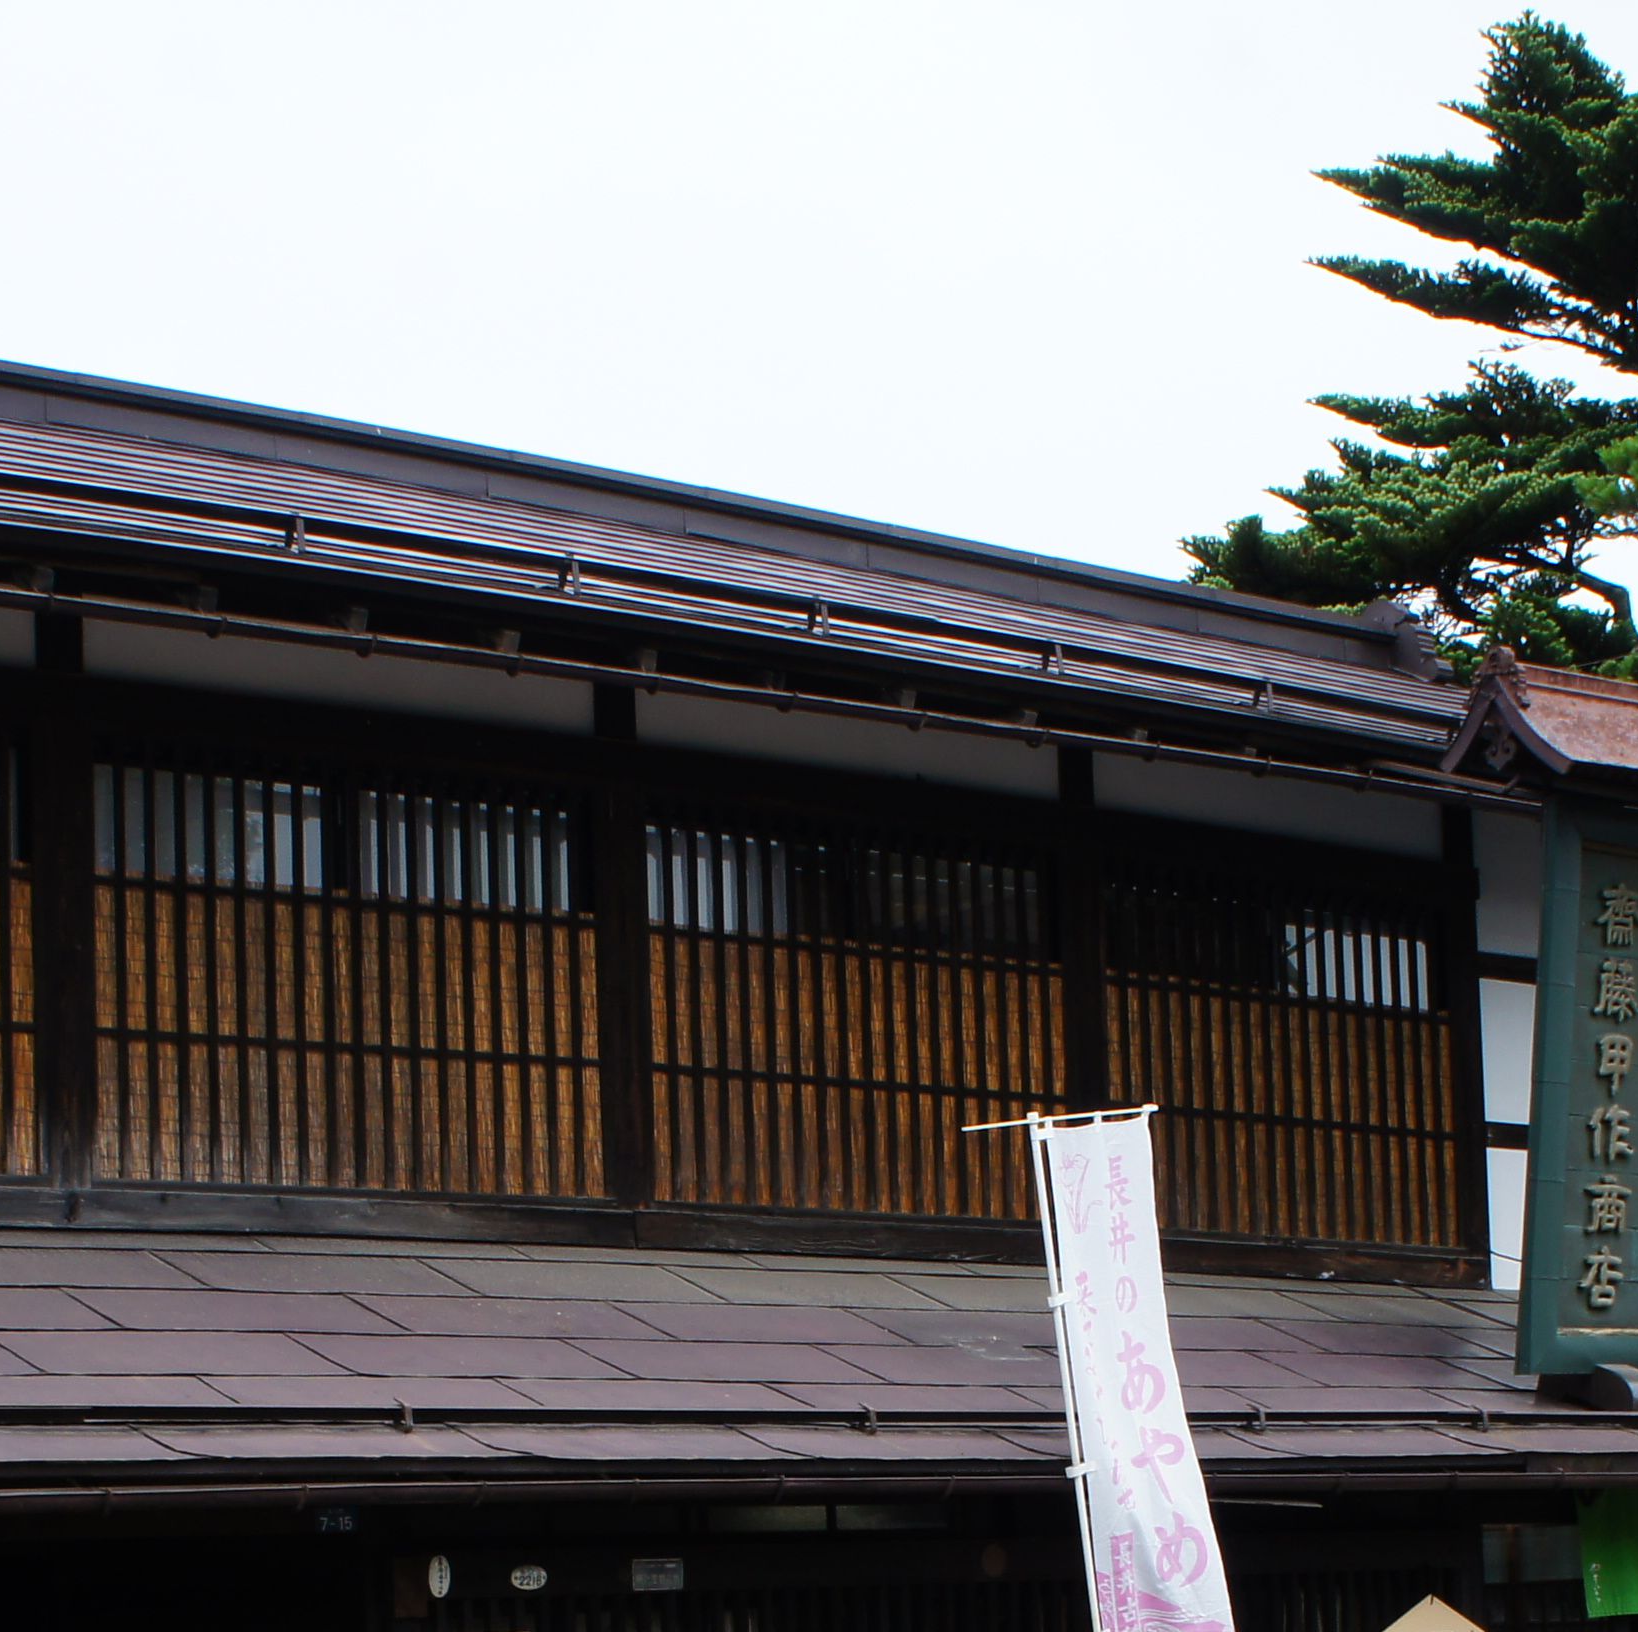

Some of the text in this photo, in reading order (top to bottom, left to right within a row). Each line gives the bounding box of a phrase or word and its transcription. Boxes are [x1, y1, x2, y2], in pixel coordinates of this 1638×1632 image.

[1104, 1153, 1210, 1589] 長井のあやめ
[319, 1516, 353, 1531] 7-15
